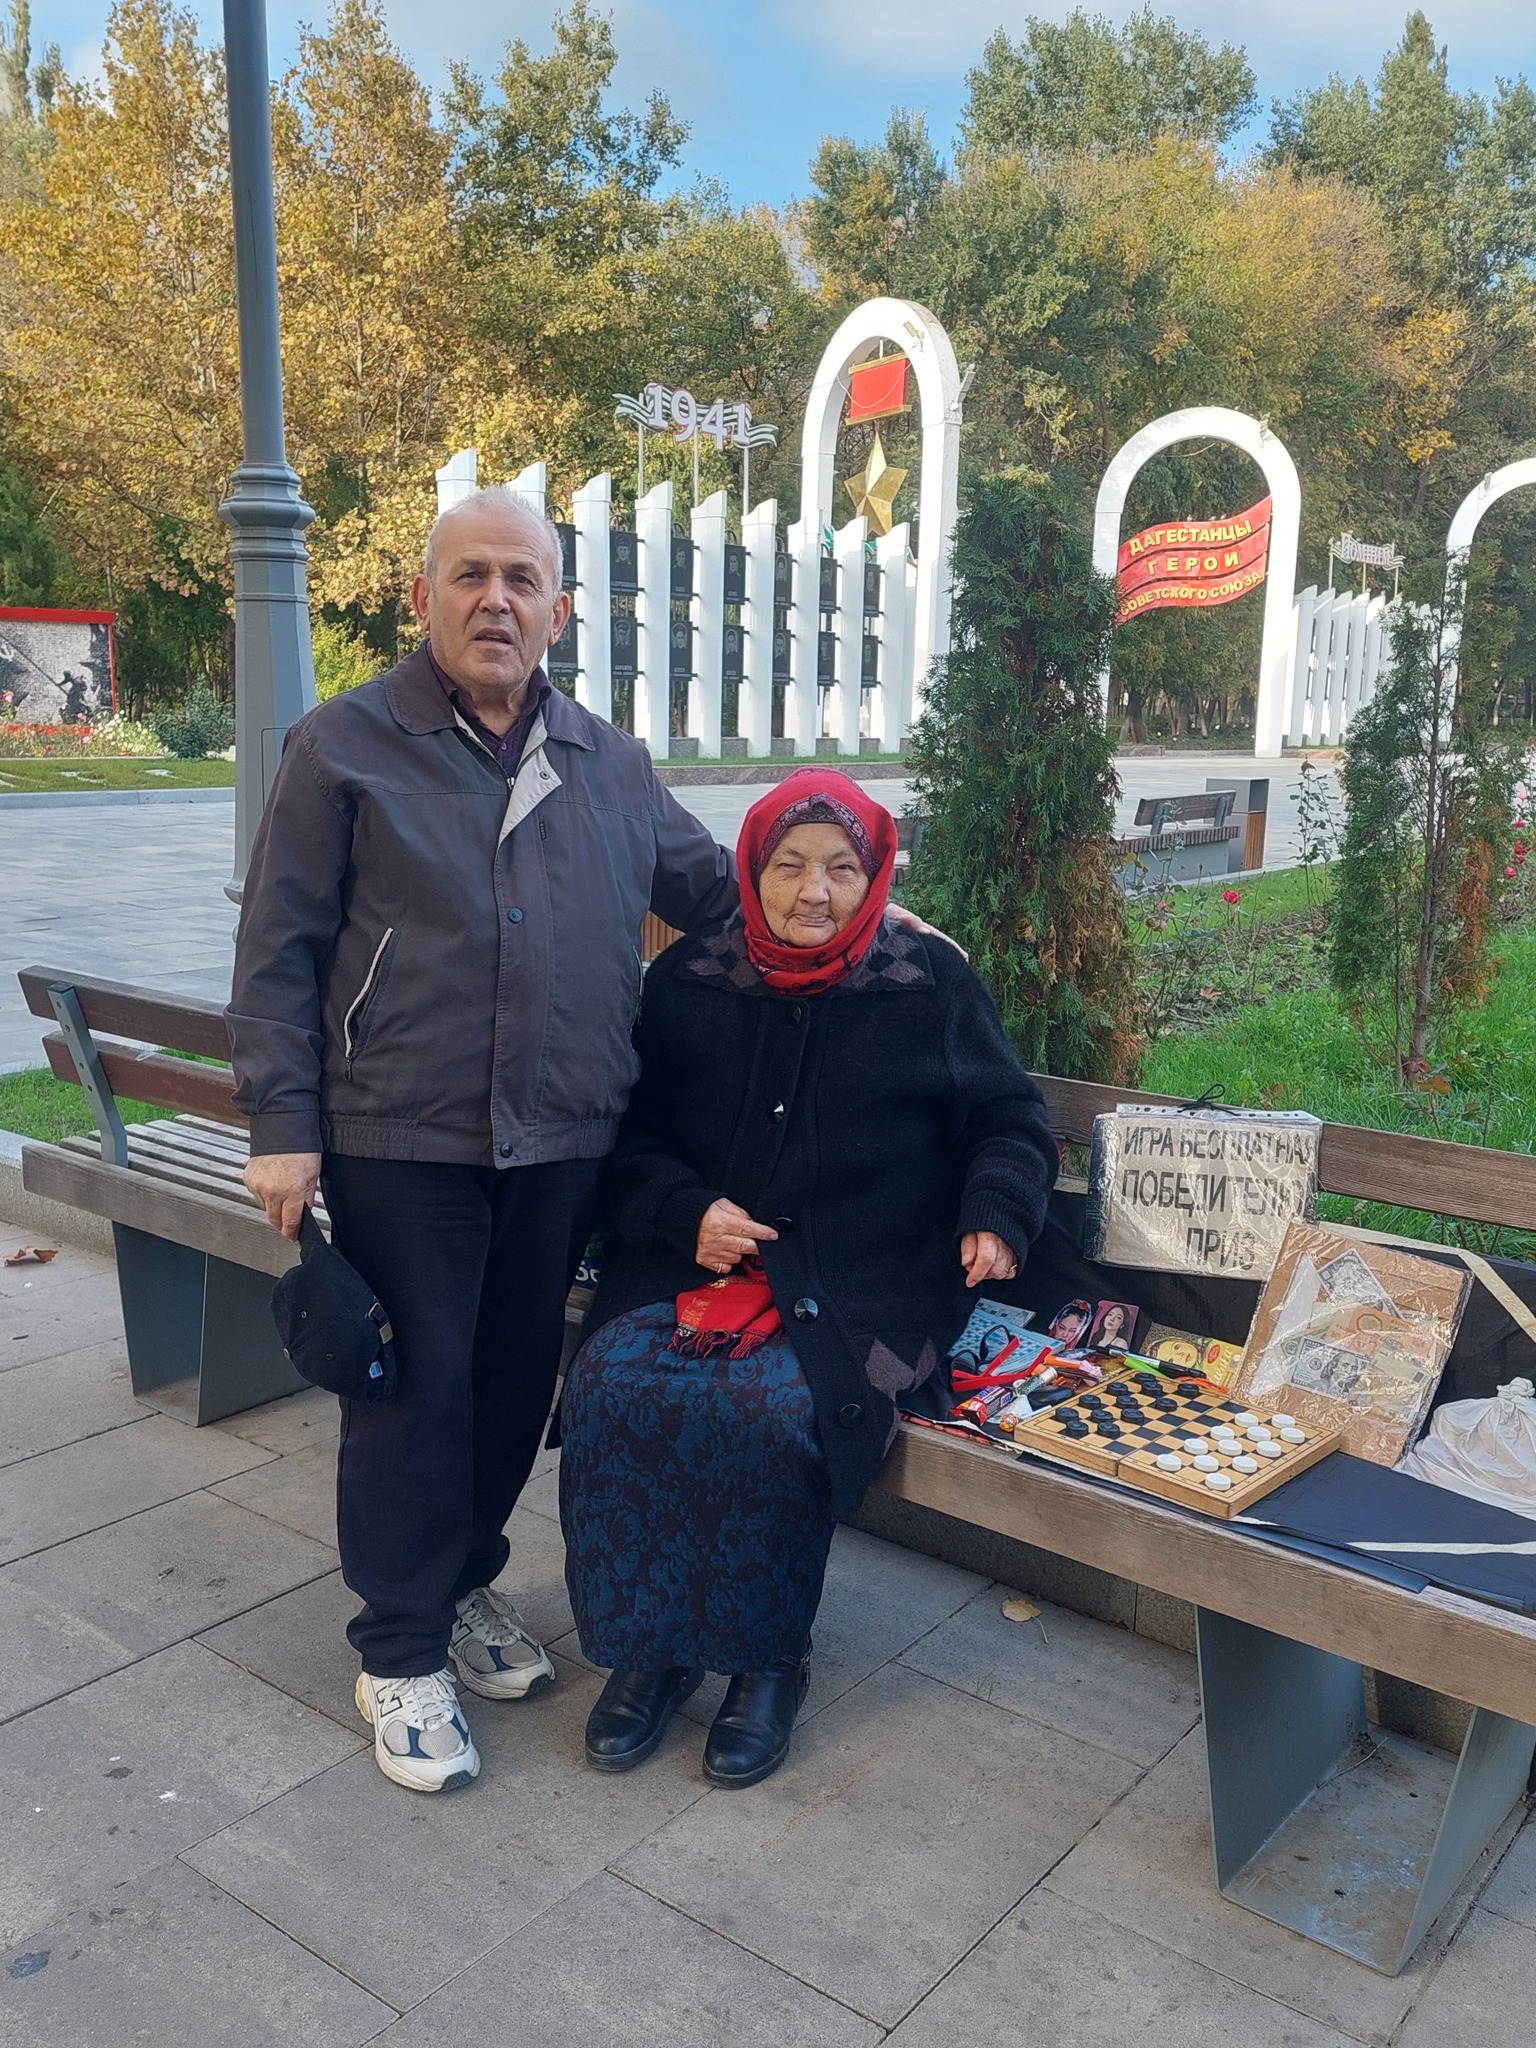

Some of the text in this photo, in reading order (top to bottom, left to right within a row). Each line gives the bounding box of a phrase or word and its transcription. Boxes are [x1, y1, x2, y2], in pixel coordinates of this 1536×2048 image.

[645, 384, 751, 451] 1941
[1129, 519, 1253, 556] ДАГЕСТАНЦЫ
[1147, 551, 1240, 575] ГЕРОИ
[1120, 571, 1262, 616] СОВЕТСКОГО СОЮЗА
[1124, 1126, 1174, 1157] ИГРА
[1185, 1227, 1256, 1271] ПРИЗ
